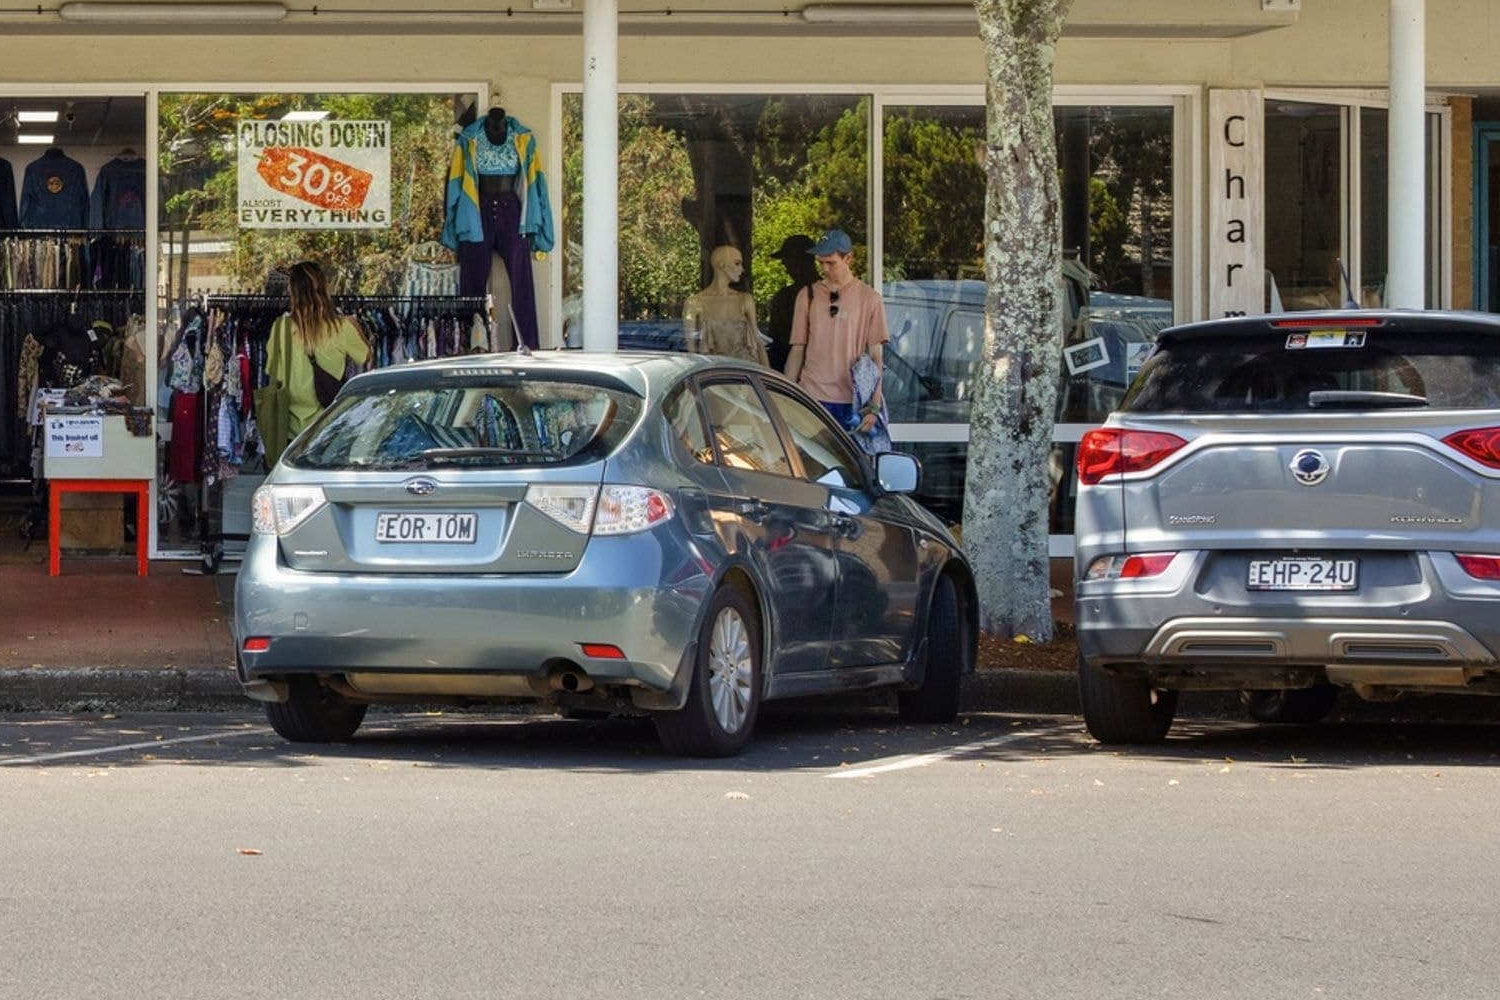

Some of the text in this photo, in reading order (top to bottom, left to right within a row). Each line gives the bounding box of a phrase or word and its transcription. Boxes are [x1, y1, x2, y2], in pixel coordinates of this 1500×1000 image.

[241, 122, 386, 148] CLOSING DOWN
[279, 152, 352, 196] 30%
[241, 199, 284, 208] ALMOST
[325, 192, 350, 205] OFF
[241, 209, 386, 222] EVERYTHING
